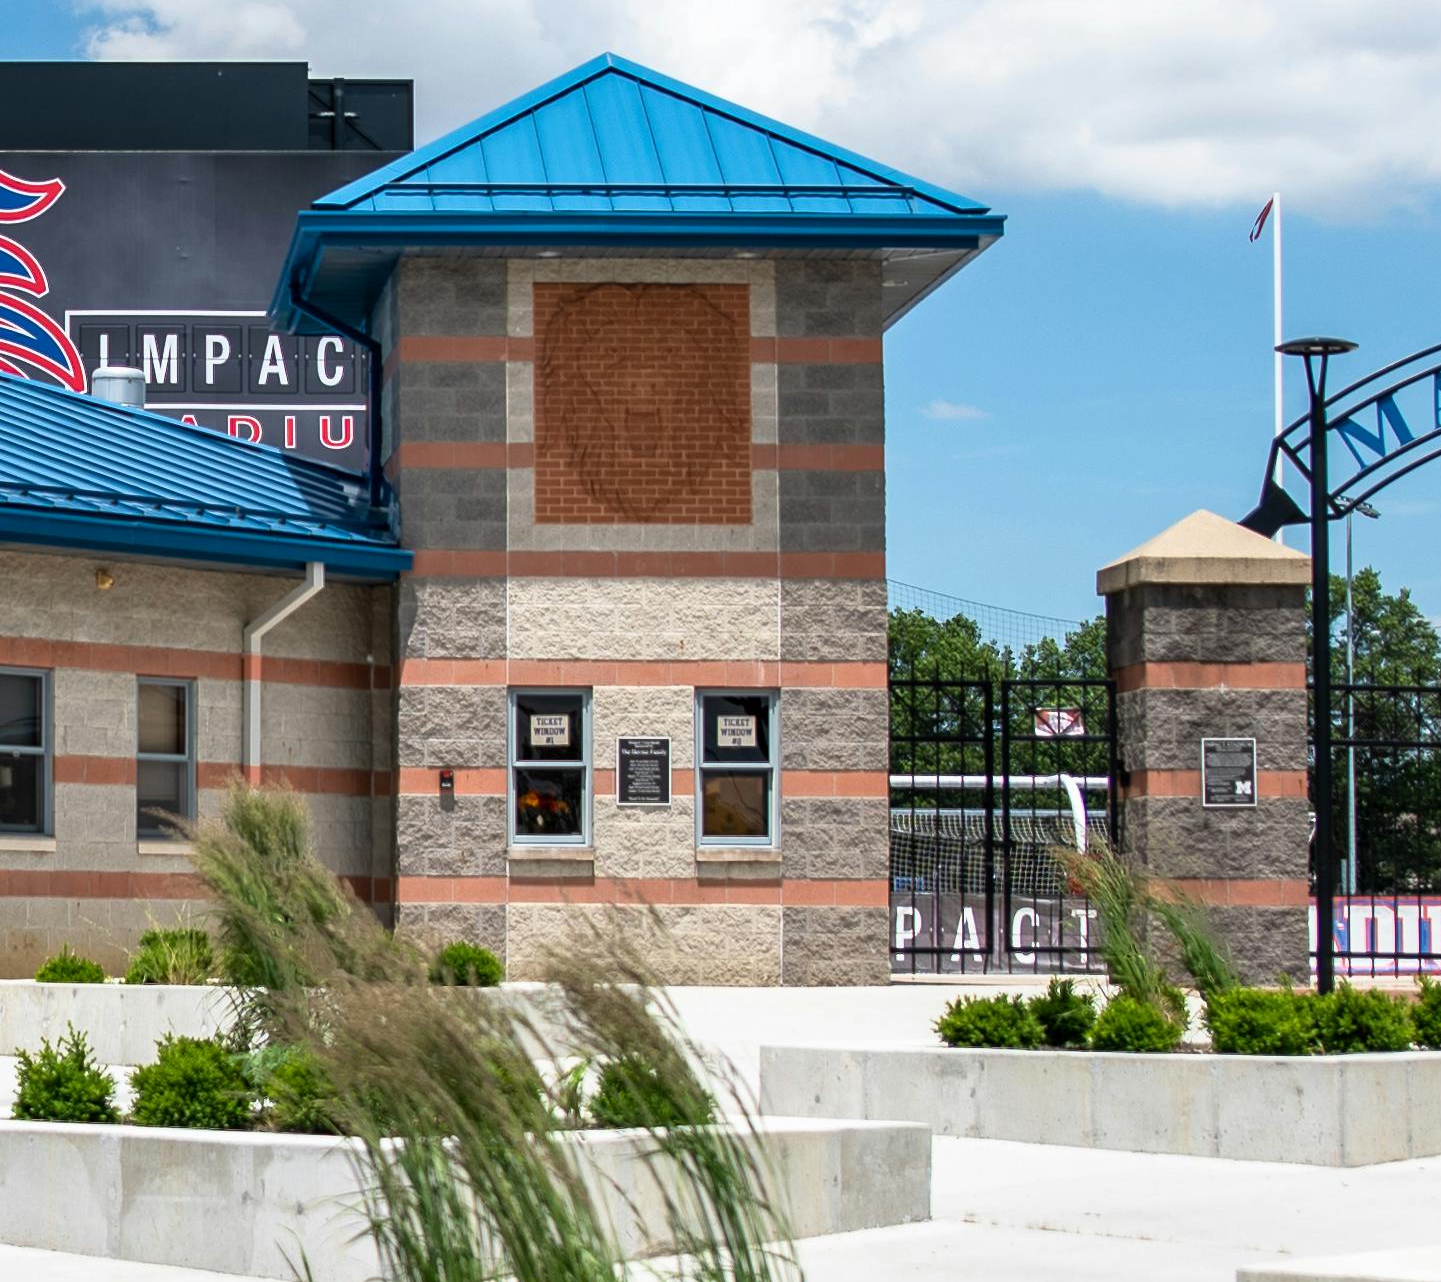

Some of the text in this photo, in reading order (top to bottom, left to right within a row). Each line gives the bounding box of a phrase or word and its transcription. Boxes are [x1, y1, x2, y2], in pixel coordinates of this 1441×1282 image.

[99, 333, 345, 387] IMPAC
[536, 717, 563, 726] TICKET
[723, 718, 750, 727] TICKET
[533, 727, 566, 736] WINDOW
[720, 728, 753, 736] WINDOW
[895, 905, 1098, 965] PACT
